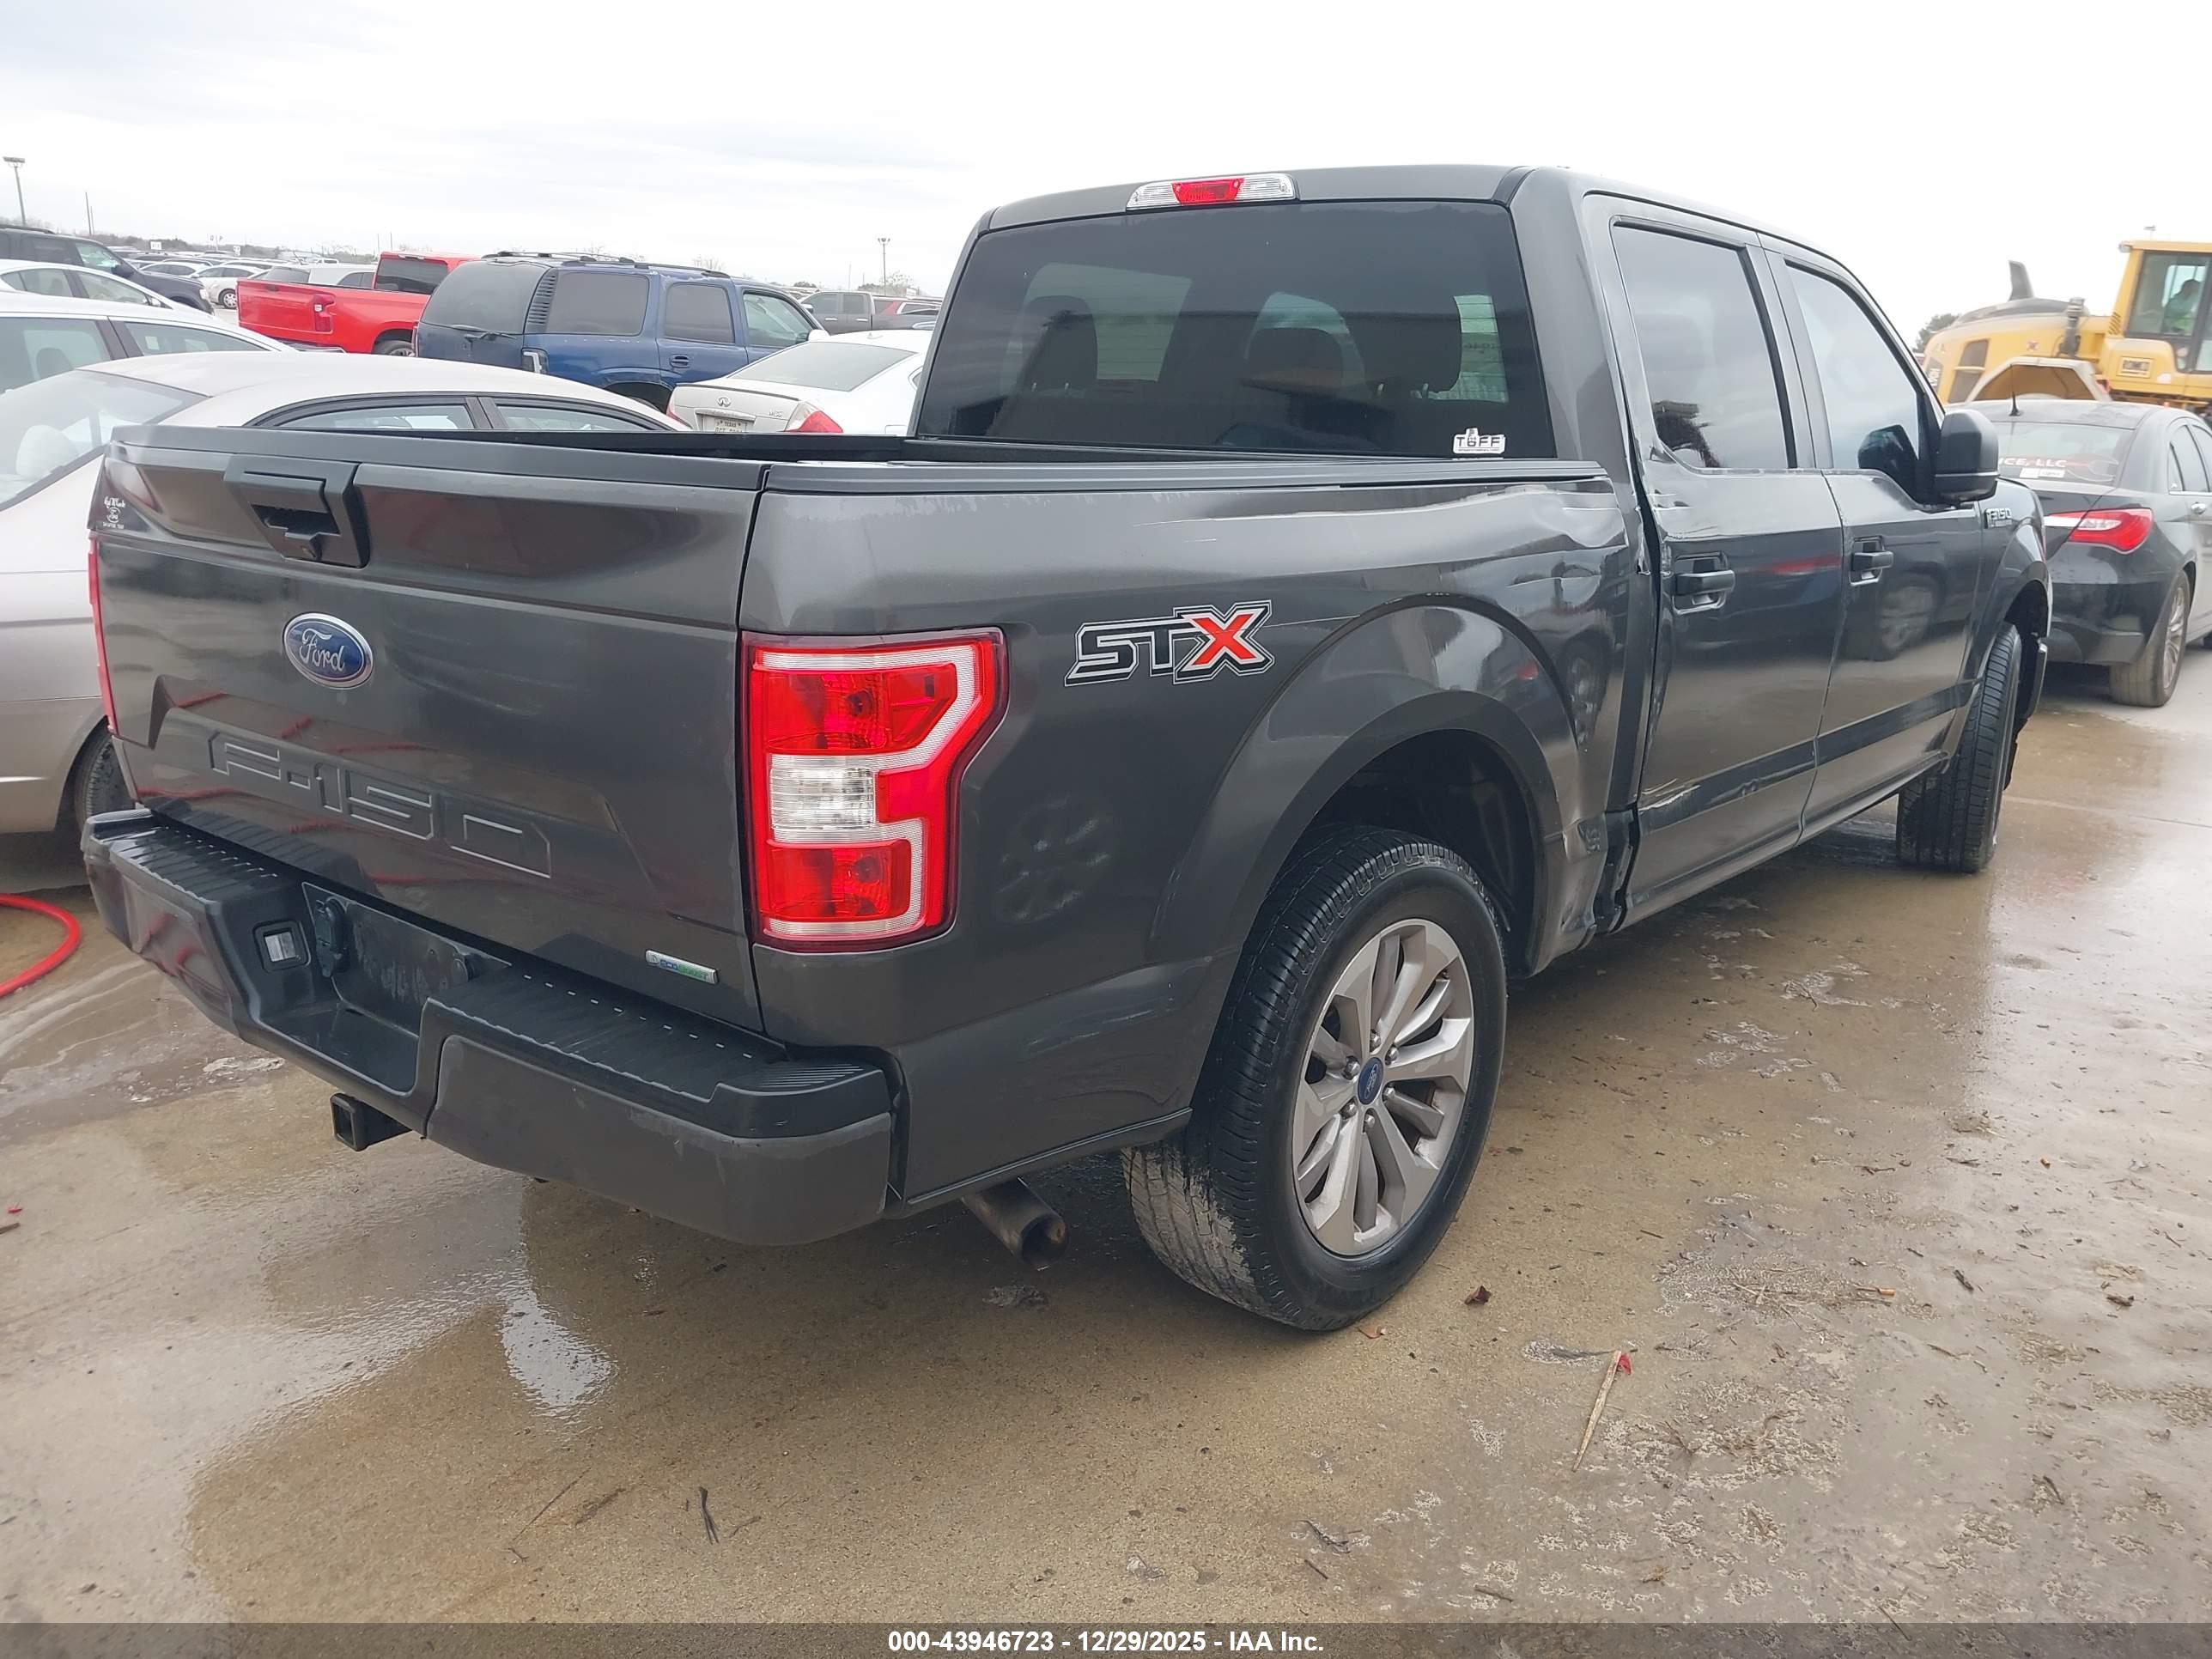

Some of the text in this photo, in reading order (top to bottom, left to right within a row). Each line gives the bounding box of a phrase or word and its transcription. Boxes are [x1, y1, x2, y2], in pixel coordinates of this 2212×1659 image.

[2035, 458, 2067, 468] LLC
[299, 628, 345, 672] Ford
[1064, 599, 1275, 687] STX
[208, 732, 551, 879] F-150
